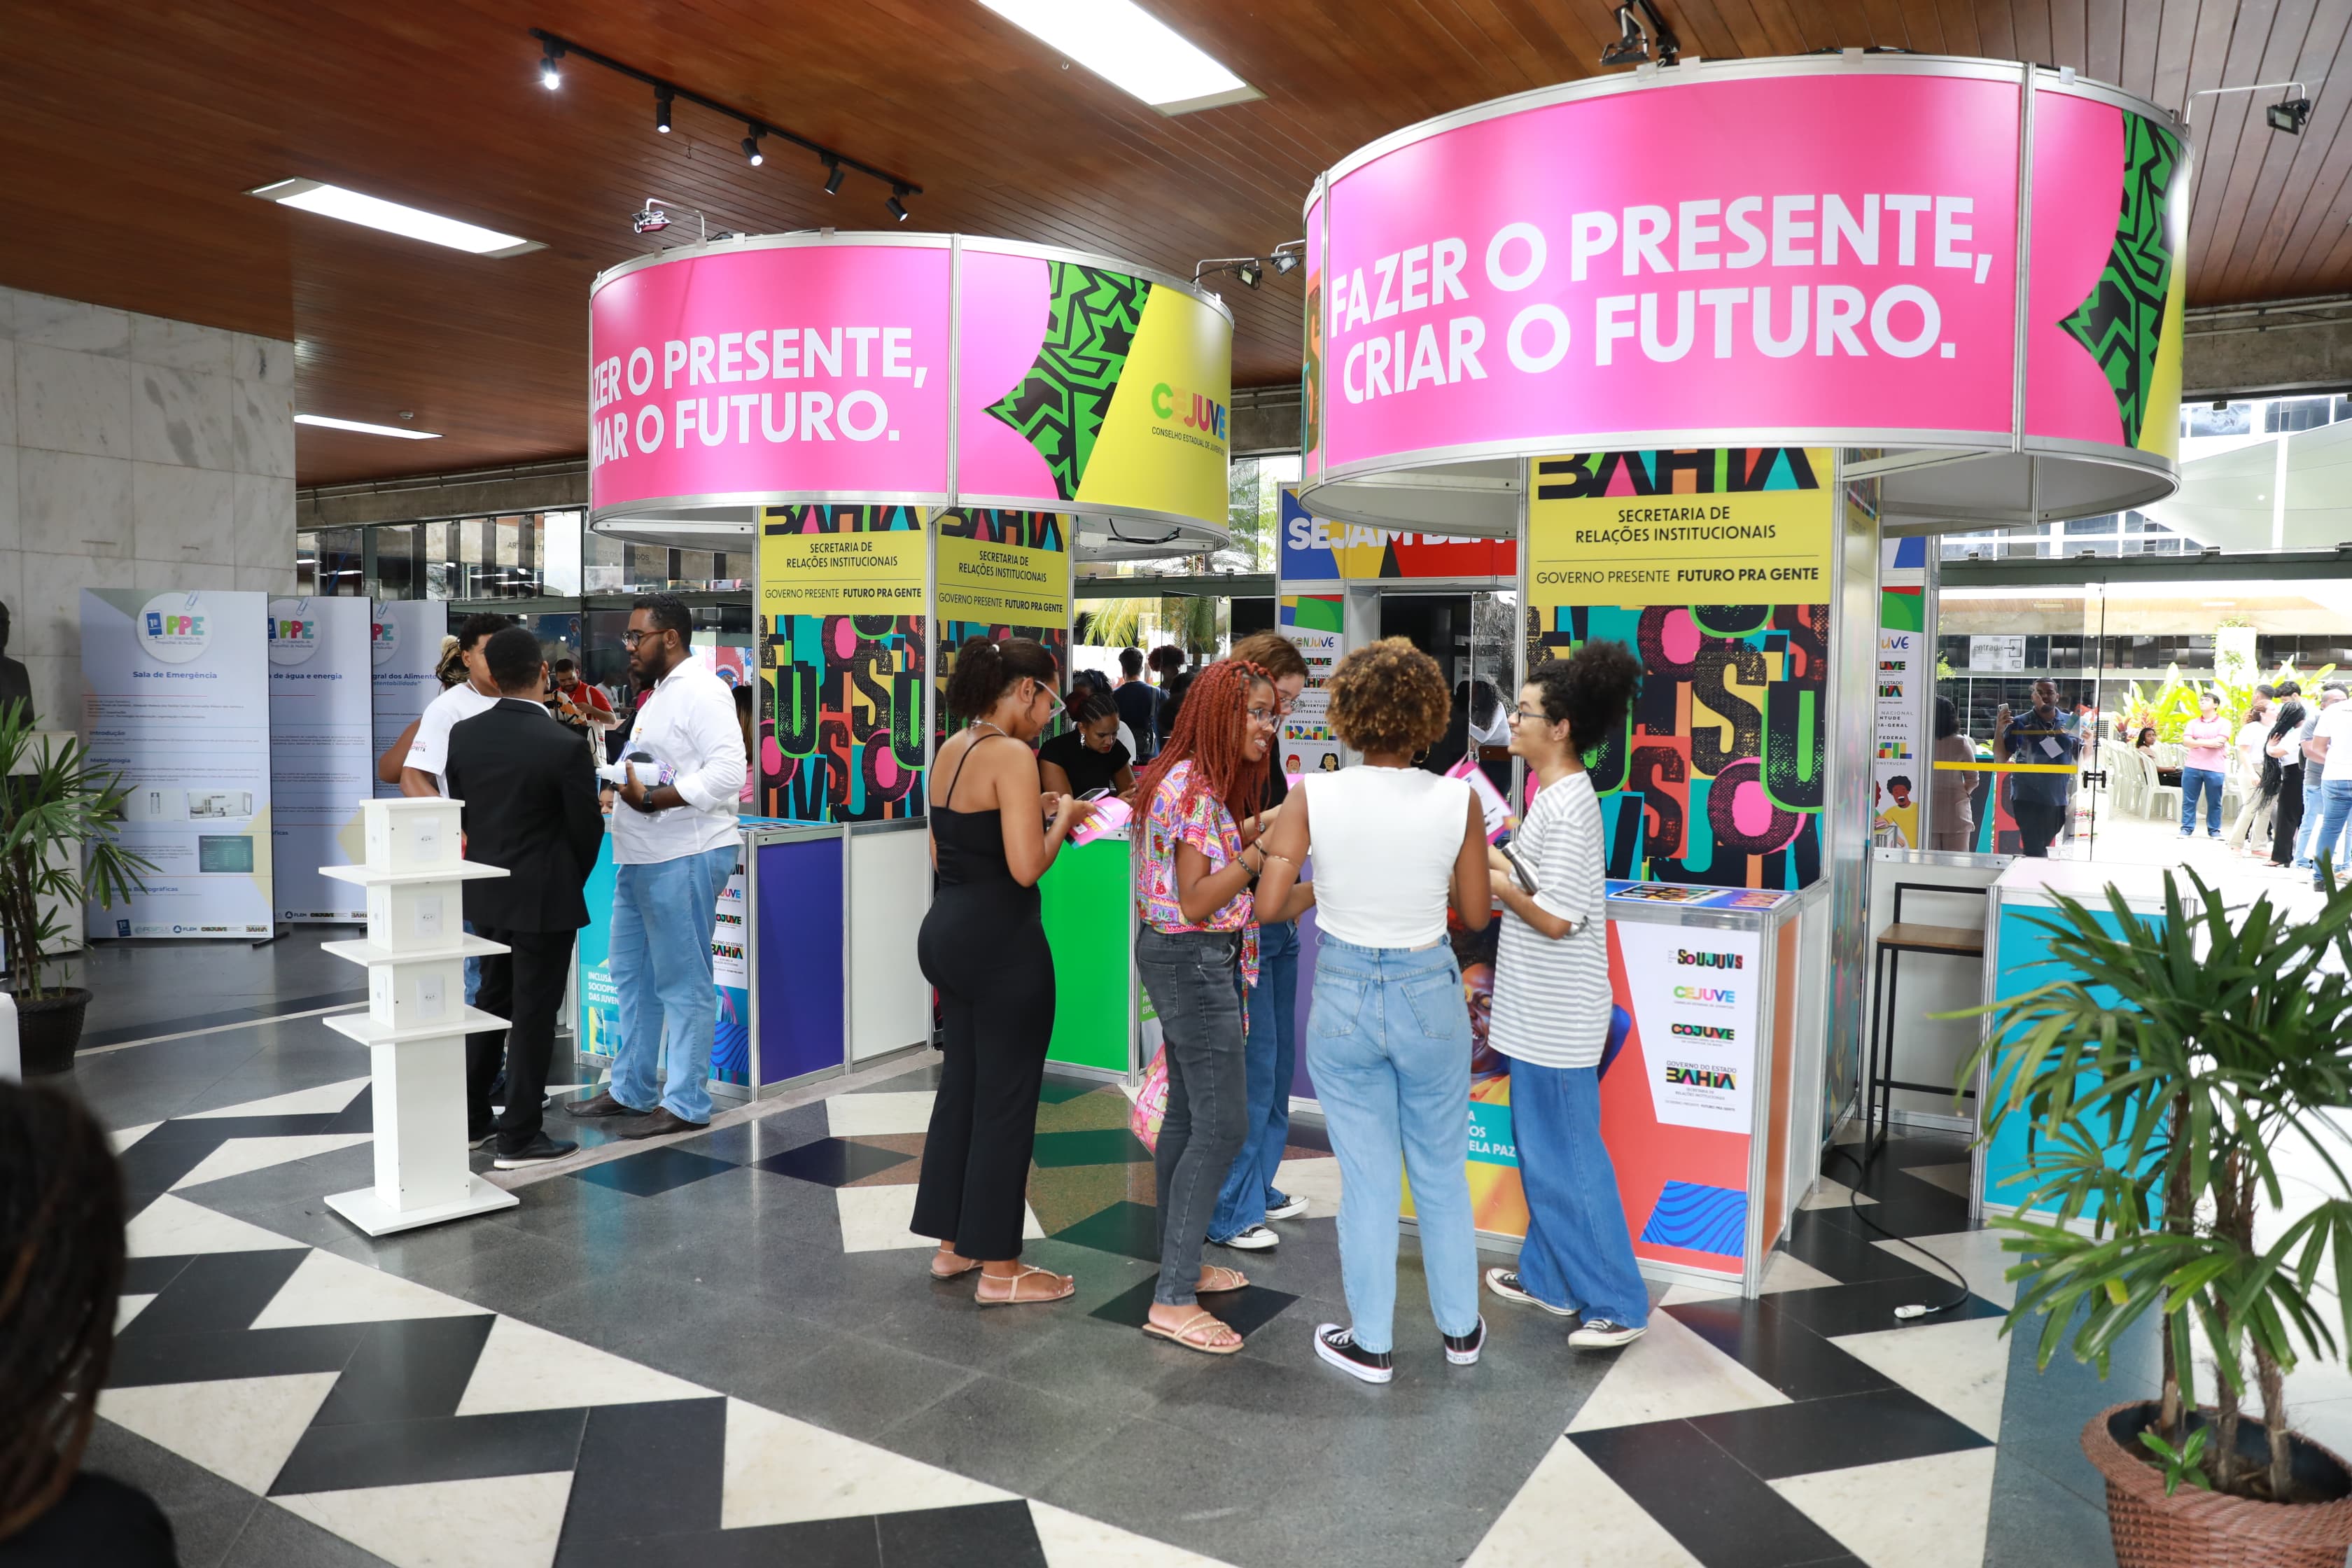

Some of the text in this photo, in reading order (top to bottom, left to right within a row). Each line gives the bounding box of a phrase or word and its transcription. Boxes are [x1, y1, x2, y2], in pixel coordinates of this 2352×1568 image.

[1331, 194, 1994, 339] FAZER O PRESENTE,
[1343, 284, 1956, 405] CRIAR O FUTURO.
[627, 346, 654, 396] O
[664, 326, 929, 389] PRESENTE,
[1152, 382, 1226, 441] CEJUVE
[636, 404, 665, 454] O
[676, 389, 901, 449] FUTURO.
[1152, 426, 1182, 441] CONSELHO
[1183, 434, 1204, 447] ESTADUAL
[1538, 447, 1820, 500] BAHIA
[764, 505, 922, 536] BAHIA
[1618, 506, 1730, 523] SECRETARIA DE
[941, 507, 1064, 553] BAHIA
[1575, 524, 1776, 545] RELAÇÕES INSTITUCIONAIS
[809, 541, 873, 554] SECRETARIA DE
[786, 555, 898, 570] RELAÇÕES INSTITUCIONAIS
[979, 550, 1029, 567] SECRETARIA DE
[958, 562, 1047, 582] RELAÇÕES INSTITUCIONAIS
[1536, 568, 1819, 584] GOVERNO PRESENTE FUTURO PRA GENTE
[764, 587, 922, 599] GOVERNO PRESENTE FUTURO PRA GENTE
[938, 592, 1063, 613] GOVERNO PRESENTE FUTURO PRA GENTE
[166, 615, 204, 636] PPE
[279, 620, 314, 638] PPE
[1973, 643, 2003, 652] entrada
[1284, 724, 1338, 741] BRASIL
[588, 992, 600, 1002] DAS
[1673, 985, 1735, 1003] CEJUVE
[1671, 1023, 1735, 1041] COJUVE
[1666, 1060, 1699, 1070] GOVERNO
[1711, 1065, 1737, 1074] ESTADO
[1665, 1066, 1736, 1091] BAHIA
[1469, 1124, 1486, 1138] OS
[1469, 1140, 1516, 1158] ELA PAZ
